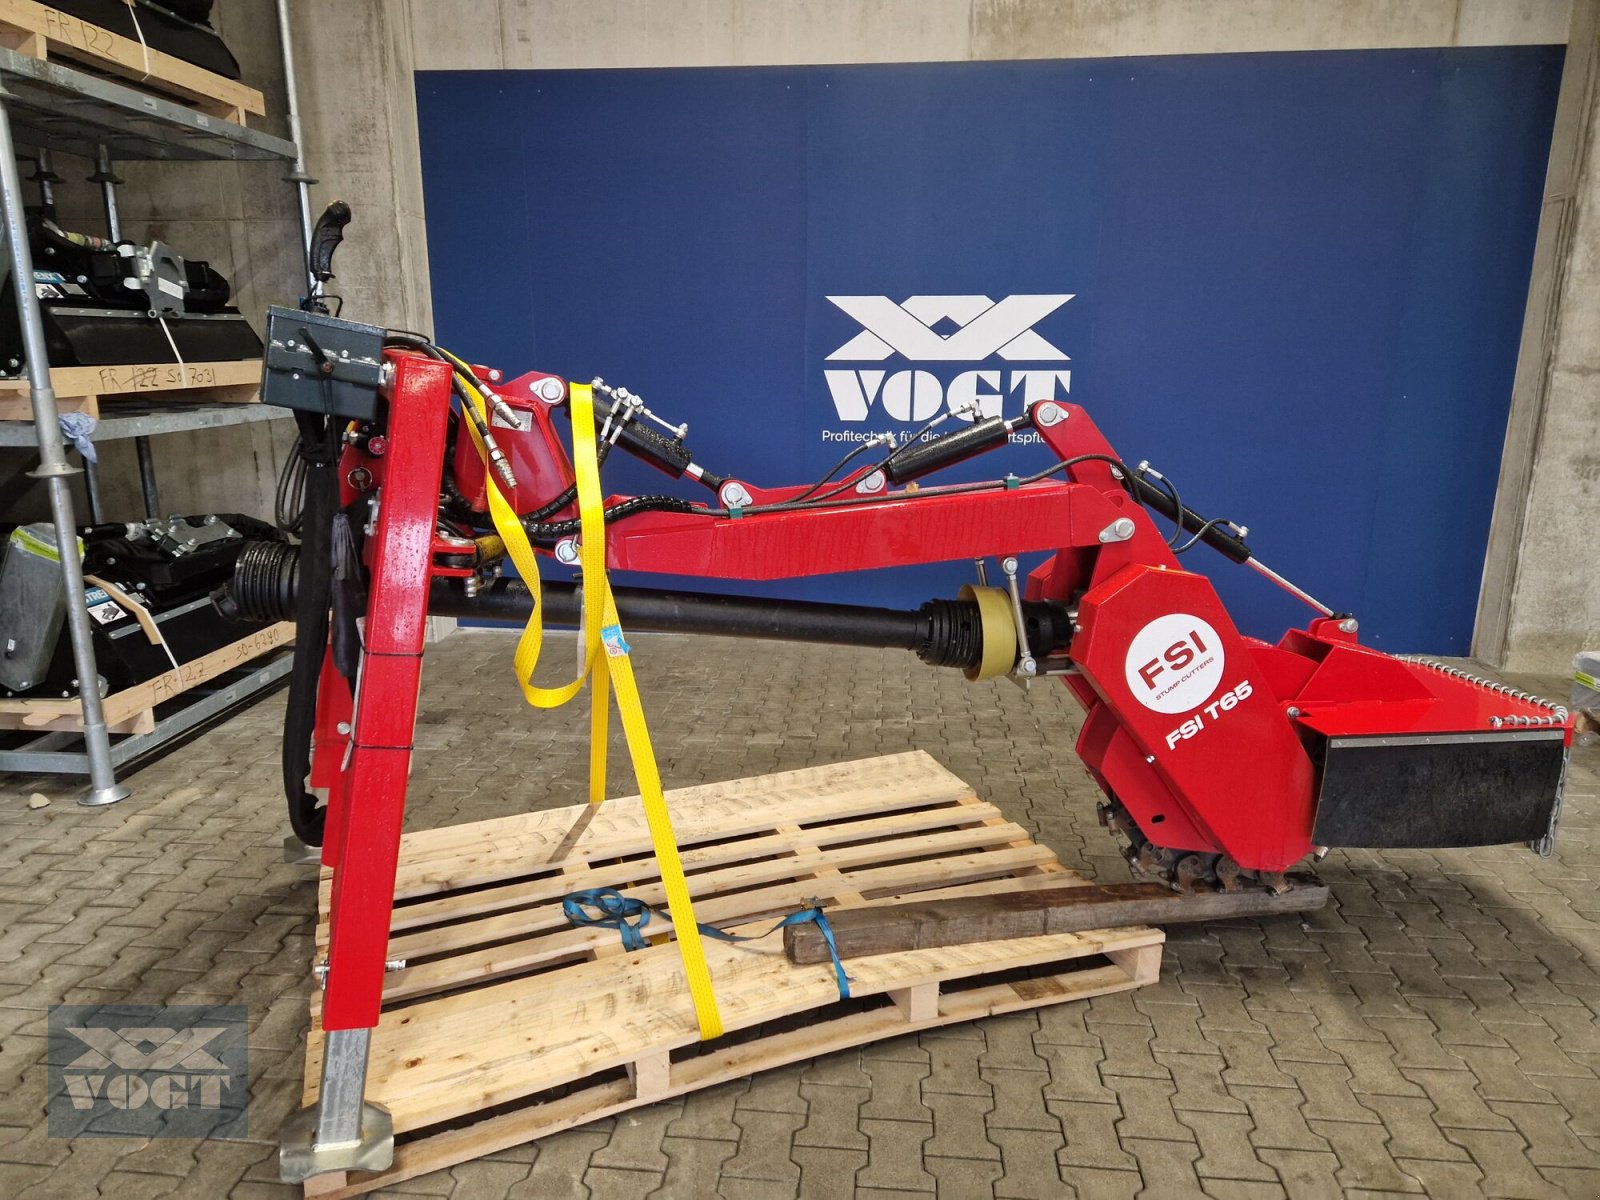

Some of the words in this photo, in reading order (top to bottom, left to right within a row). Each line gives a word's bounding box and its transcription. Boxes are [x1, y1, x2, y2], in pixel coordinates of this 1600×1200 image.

[45, 9, 74, 45] FR
[80, 21, 120, 60] 122
[99, 368, 122, 393] FR
[824, 370, 1071, 422] VOGT
[1138, 630, 1207, 690] FSI
[1155, 680, 1181, 701] STUMP
[1181, 656, 1215, 683] CUTTERS
[1165, 714, 1205, 751] FSI
[1203, 679, 1253, 720] T65
